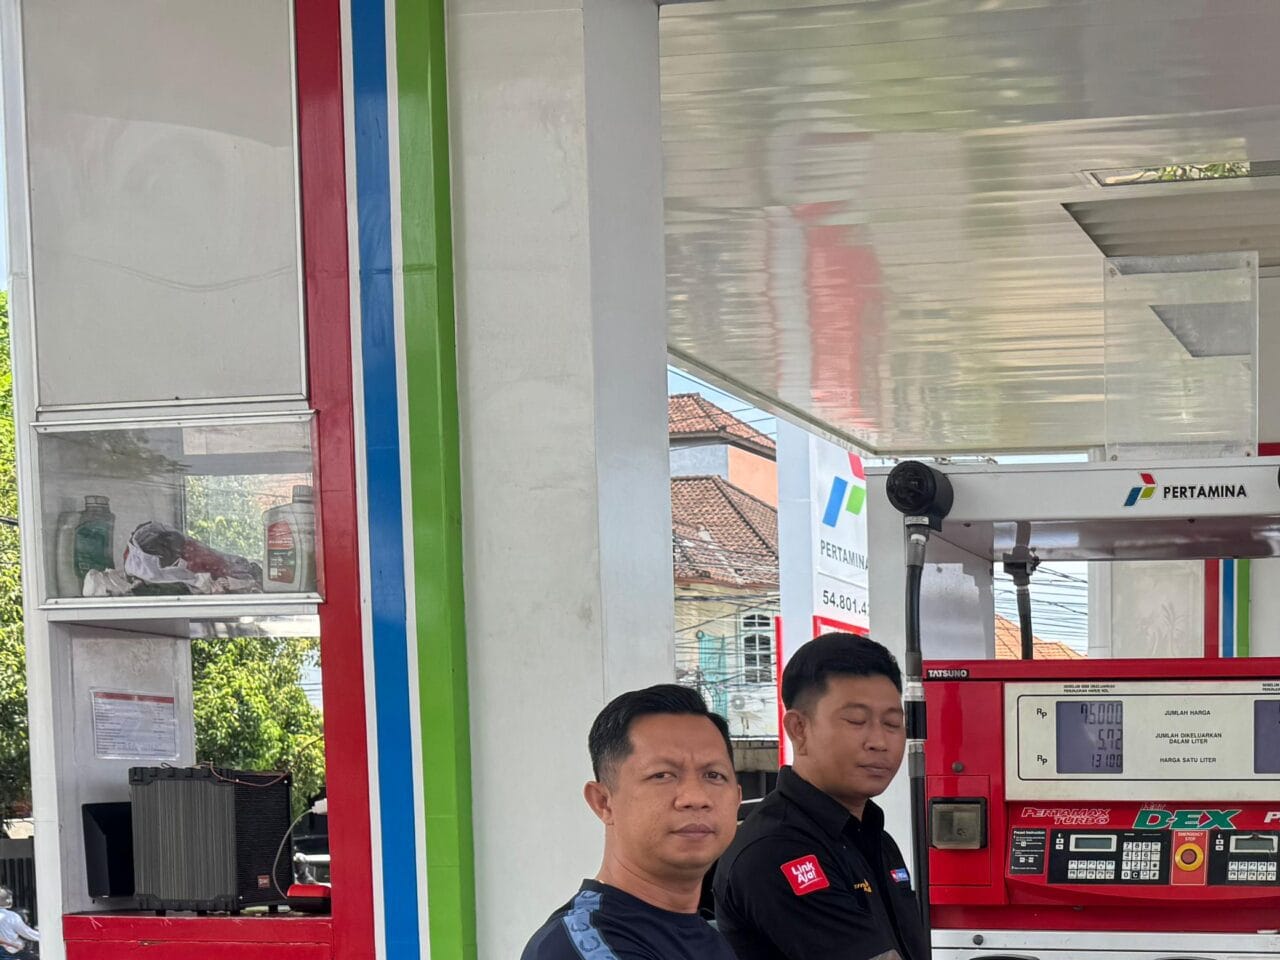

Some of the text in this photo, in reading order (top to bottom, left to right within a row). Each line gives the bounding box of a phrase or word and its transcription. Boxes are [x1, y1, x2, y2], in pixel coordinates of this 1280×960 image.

[1163, 485, 1247, 498] PERTAMINA
[823, 589, 869, 615] 54.801.4
[928, 670, 967, 678] TATSUNO
[1022, 807, 1112, 817] PERTAMAX
[1054, 816, 1110, 825] TURBO
[791, 861, 815, 876] Link
